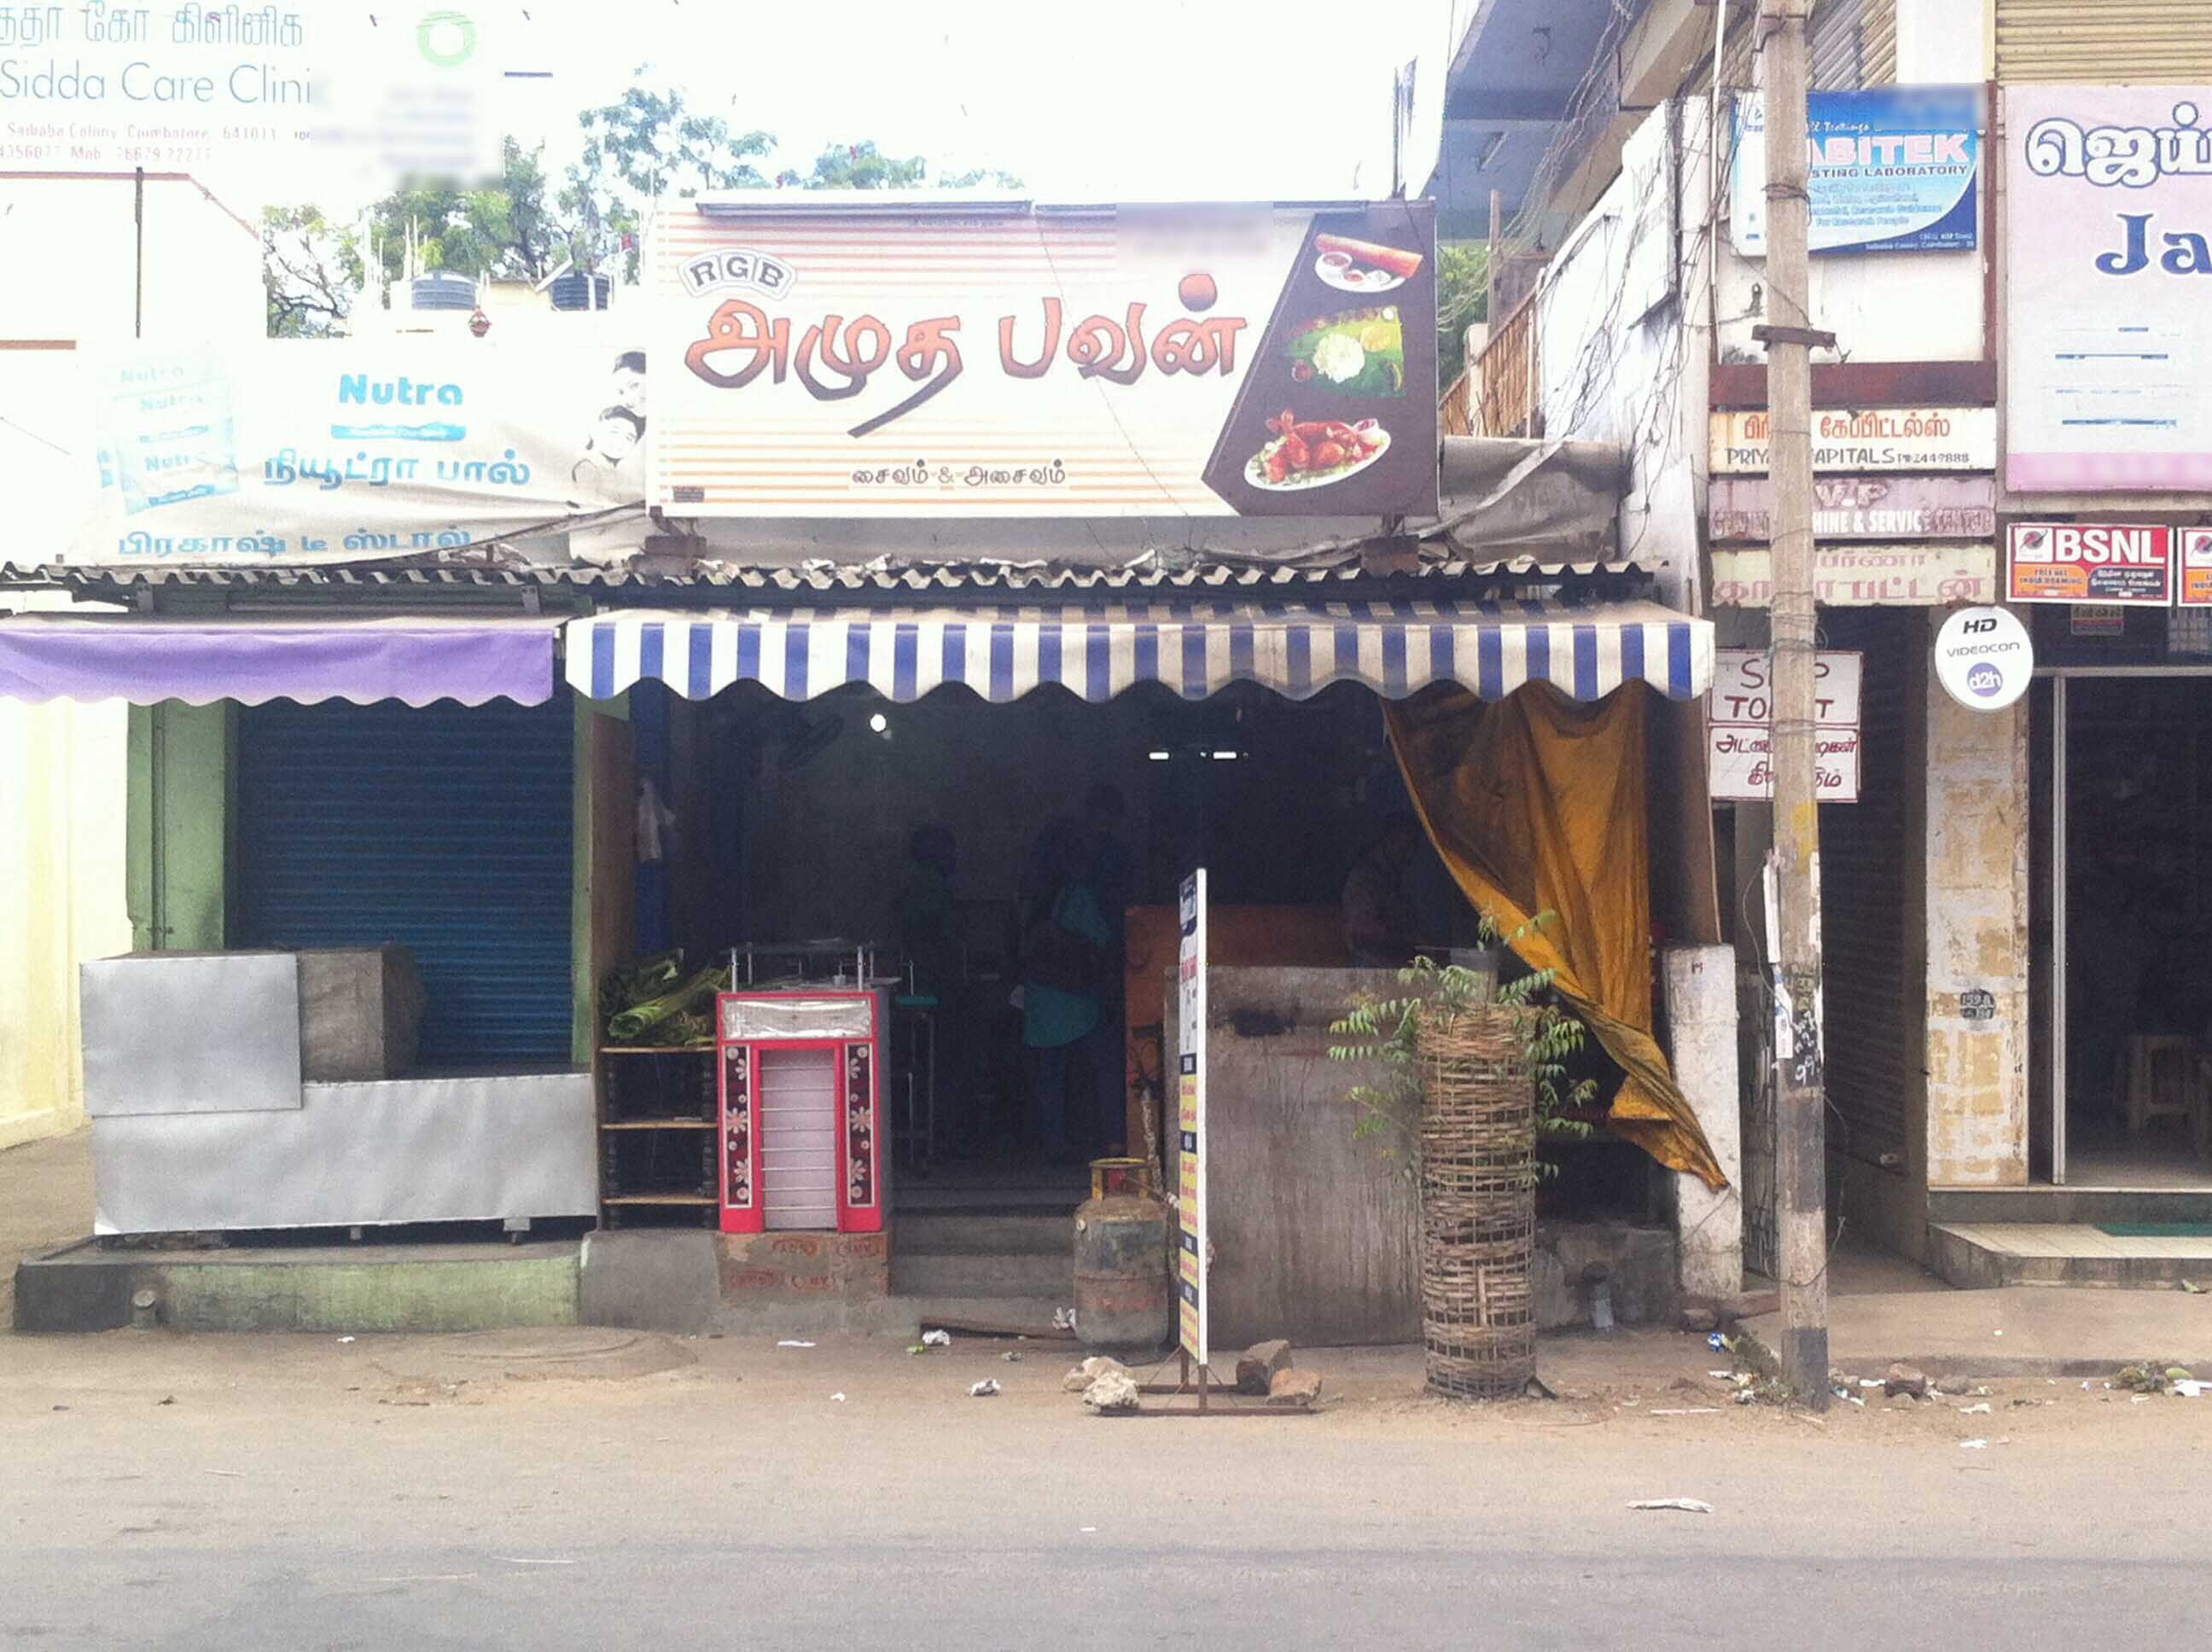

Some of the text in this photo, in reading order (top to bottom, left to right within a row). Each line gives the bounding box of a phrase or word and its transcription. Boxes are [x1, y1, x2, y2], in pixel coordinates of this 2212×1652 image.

[0, 59, 313, 104] Sidda Care Clini
[1812, 166, 1968, 178] STING LABORATORY
[689, 256, 785, 288] RGB
[684, 272, 1248, 439] அமுத பவன்
[338, 373, 465, 406] Nutra
[436, 449, 531, 486] பால்
[1810, 447, 1895, 465] APITALS
[852, 458, 1066, 486] சைவம் & அசைவம்
[1812, 510, 1849, 533] HINE
[2055, 528, 2166, 564] BSNL
[1963, 619, 1998, 634] HD
[1741, 658, 1830, 689] SP
[1968, 670, 2002, 690] d2h
